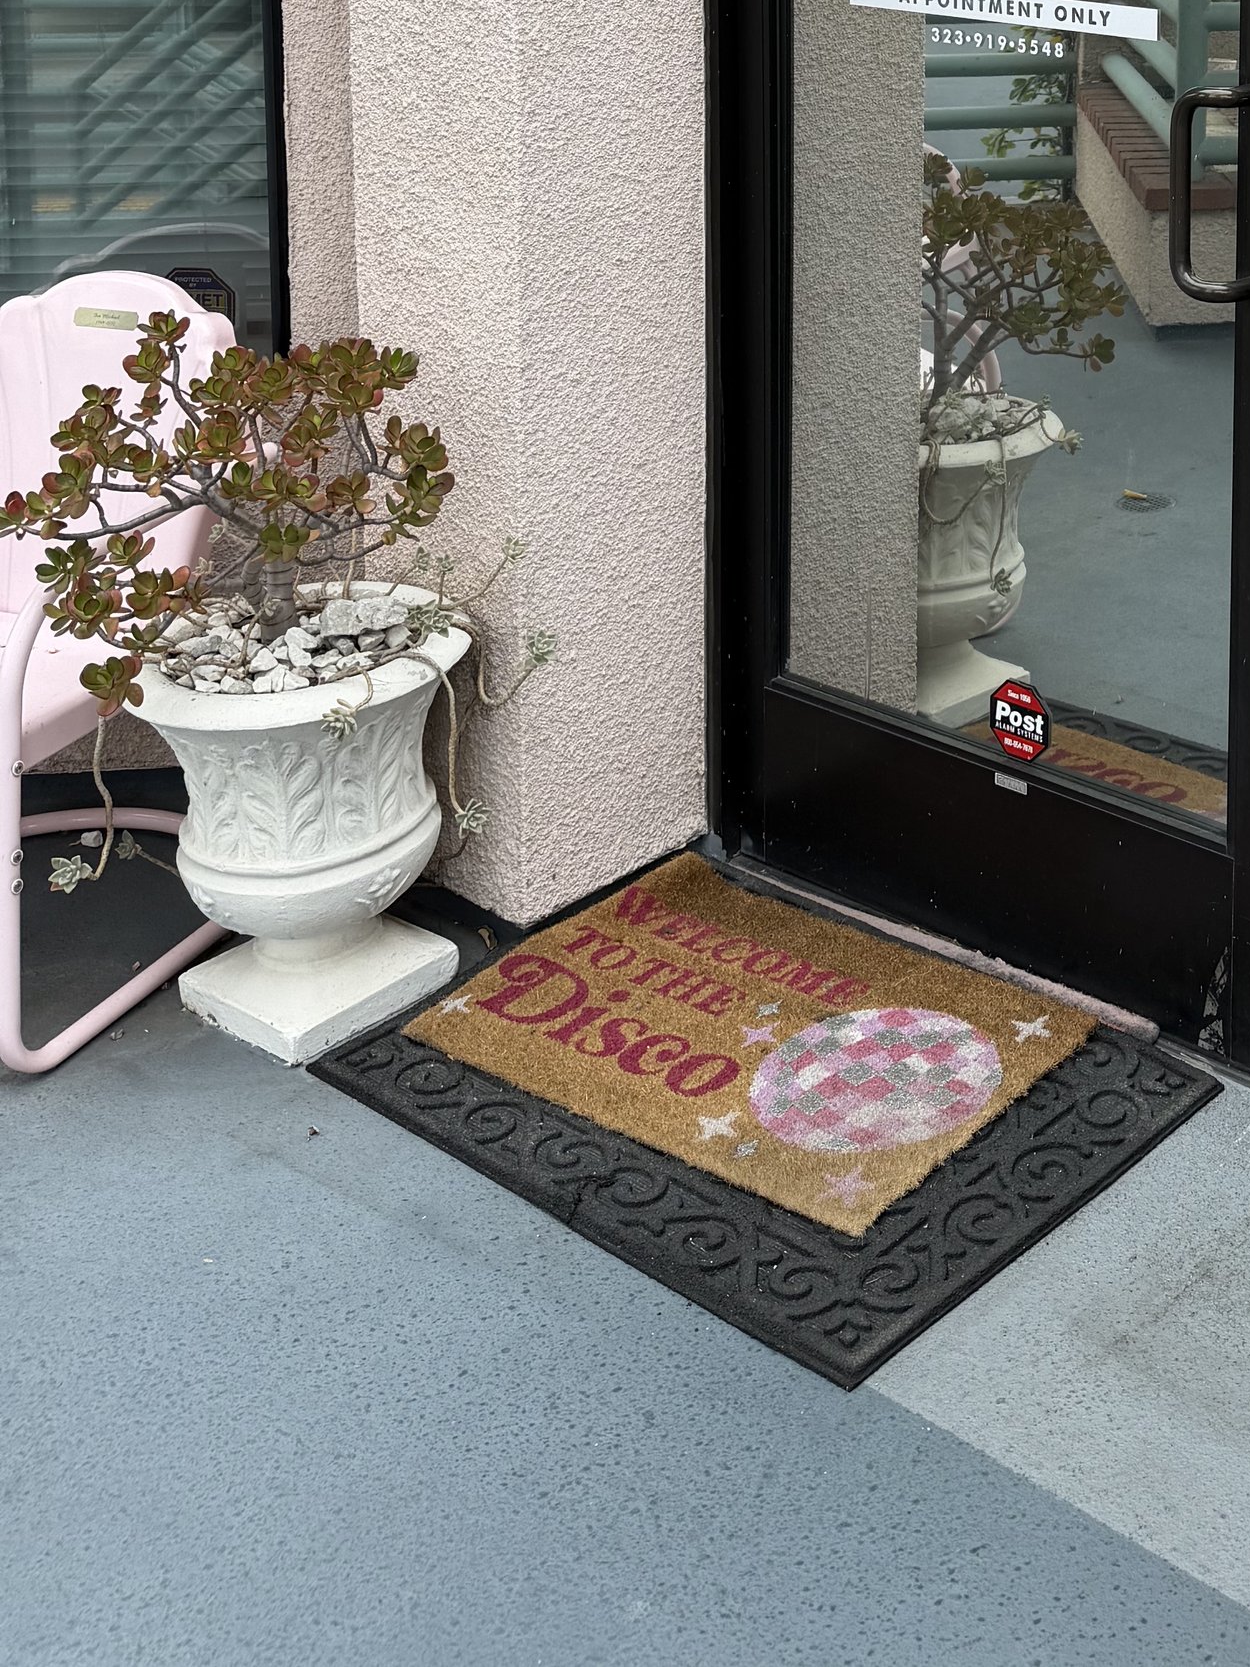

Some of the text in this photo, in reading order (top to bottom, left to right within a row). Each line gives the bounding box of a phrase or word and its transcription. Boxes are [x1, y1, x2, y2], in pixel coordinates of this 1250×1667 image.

[1054, 6, 1111, 27] ONLY
[995, 700, 1044, 735] Post
[995, 721, 1043, 743] ALARM SYSTEMS
[562, 925, 746, 1017] TO THE
[614, 886, 872, 1007] WELCOME
[476, 953, 741, 1098] Disco
